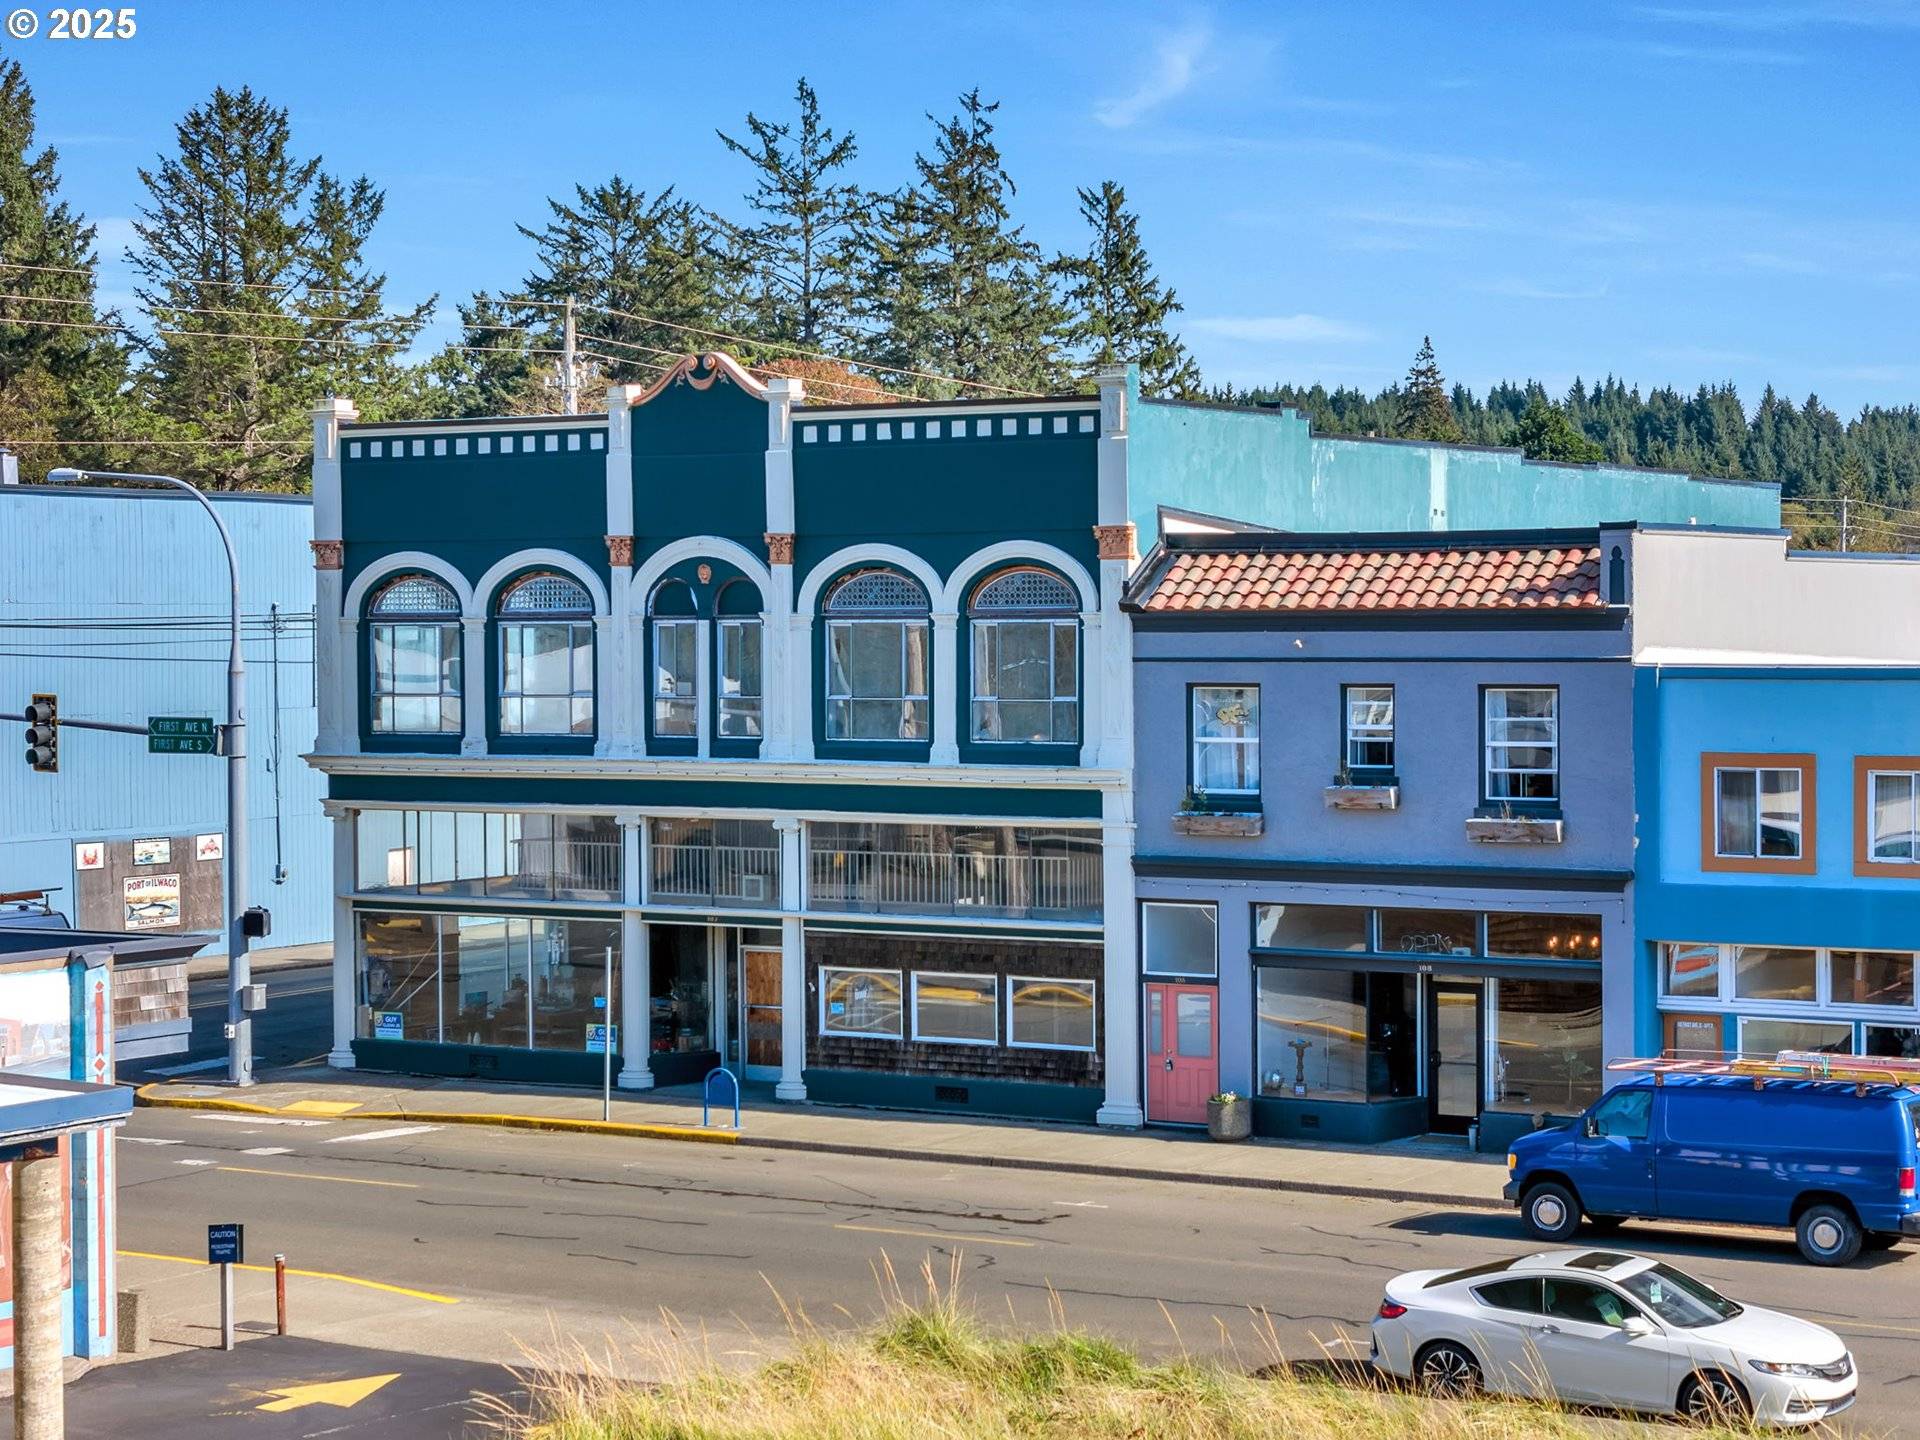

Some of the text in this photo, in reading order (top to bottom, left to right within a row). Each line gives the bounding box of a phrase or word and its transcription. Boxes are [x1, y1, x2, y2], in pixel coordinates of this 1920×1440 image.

[159, 721, 208, 733] FIRST AVE N
[153, 738, 203, 751] FIRST AVE S
[127, 880, 145, 892] PORT
[151, 878, 177, 888] ILWACO
[137, 918, 165, 926] SALMON
[1418, 964, 1433, 972] 108
[210, 1230, 236, 1238] CAUTION
